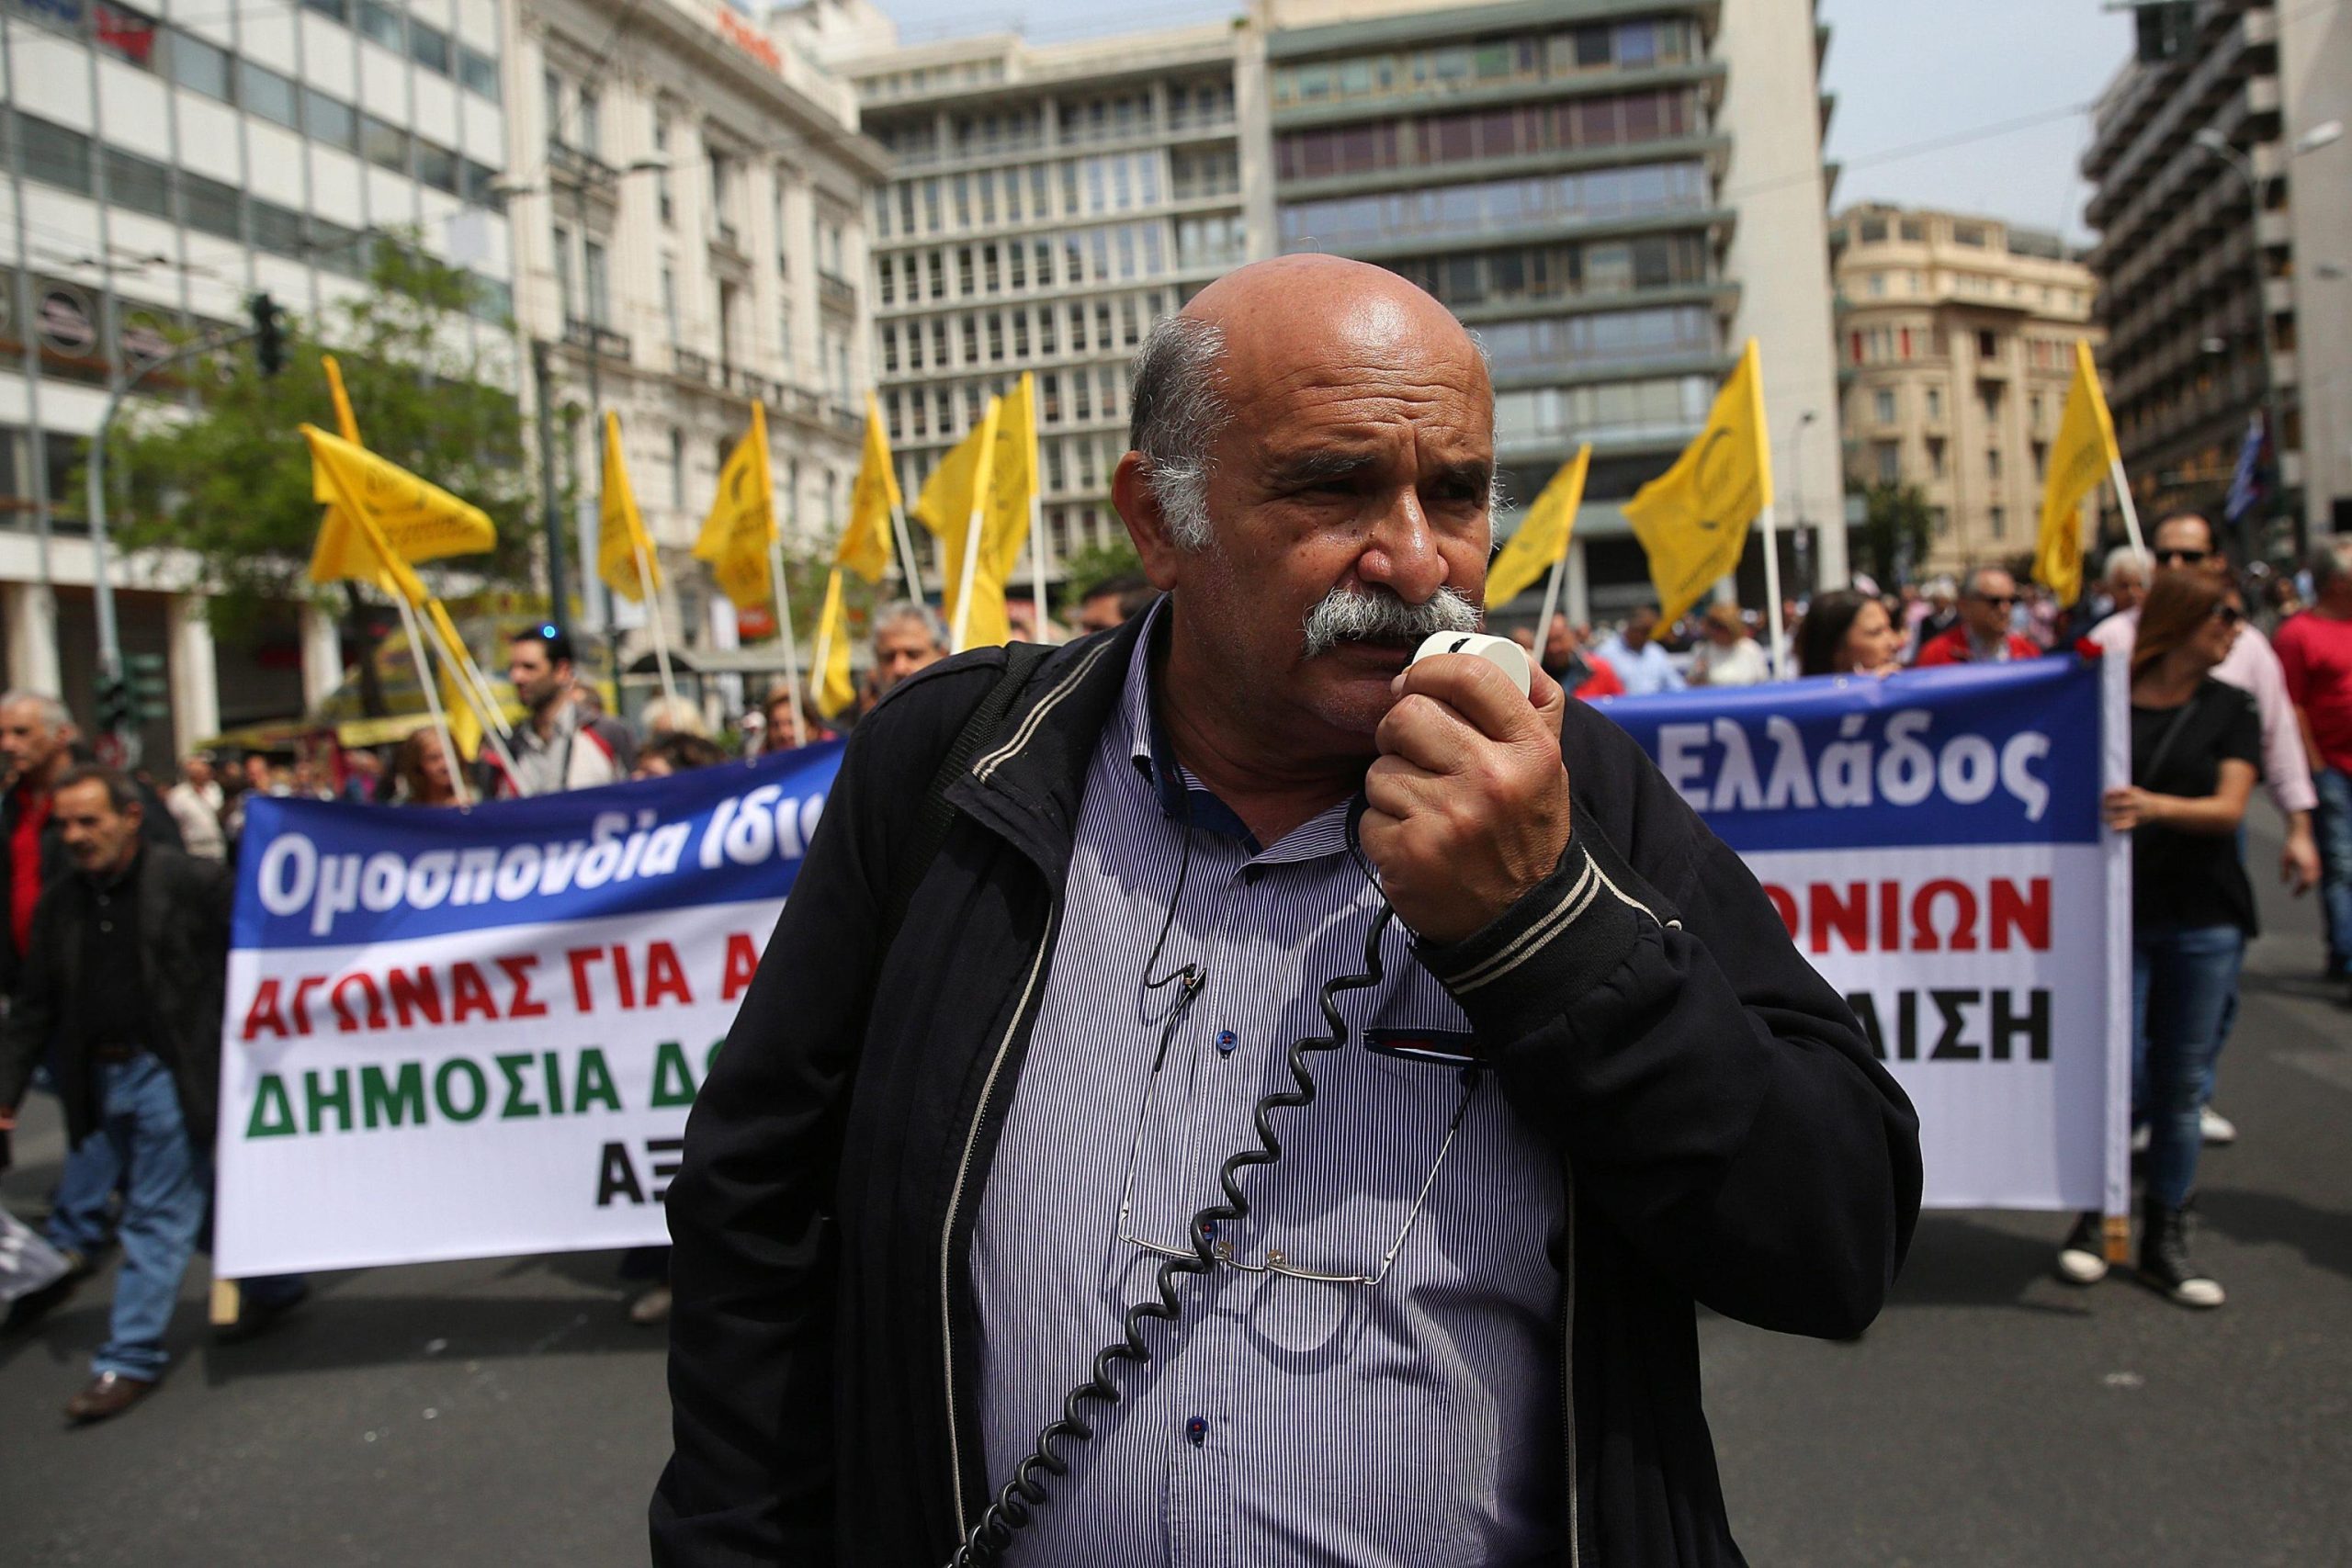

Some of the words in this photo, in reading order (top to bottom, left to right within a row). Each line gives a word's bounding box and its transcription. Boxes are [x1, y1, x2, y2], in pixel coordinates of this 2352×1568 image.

[257, 809, 694, 937] Ομοσπονδία
[1657, 710, 2052, 821] Ελλάδος
[242, 953, 548, 1042] ΑΓΩΝΑΣ
[566, 941, 694, 1013] ΓΙΑ
[244, 1047, 622, 1139] ΔΗΜΟΣΙΑ
